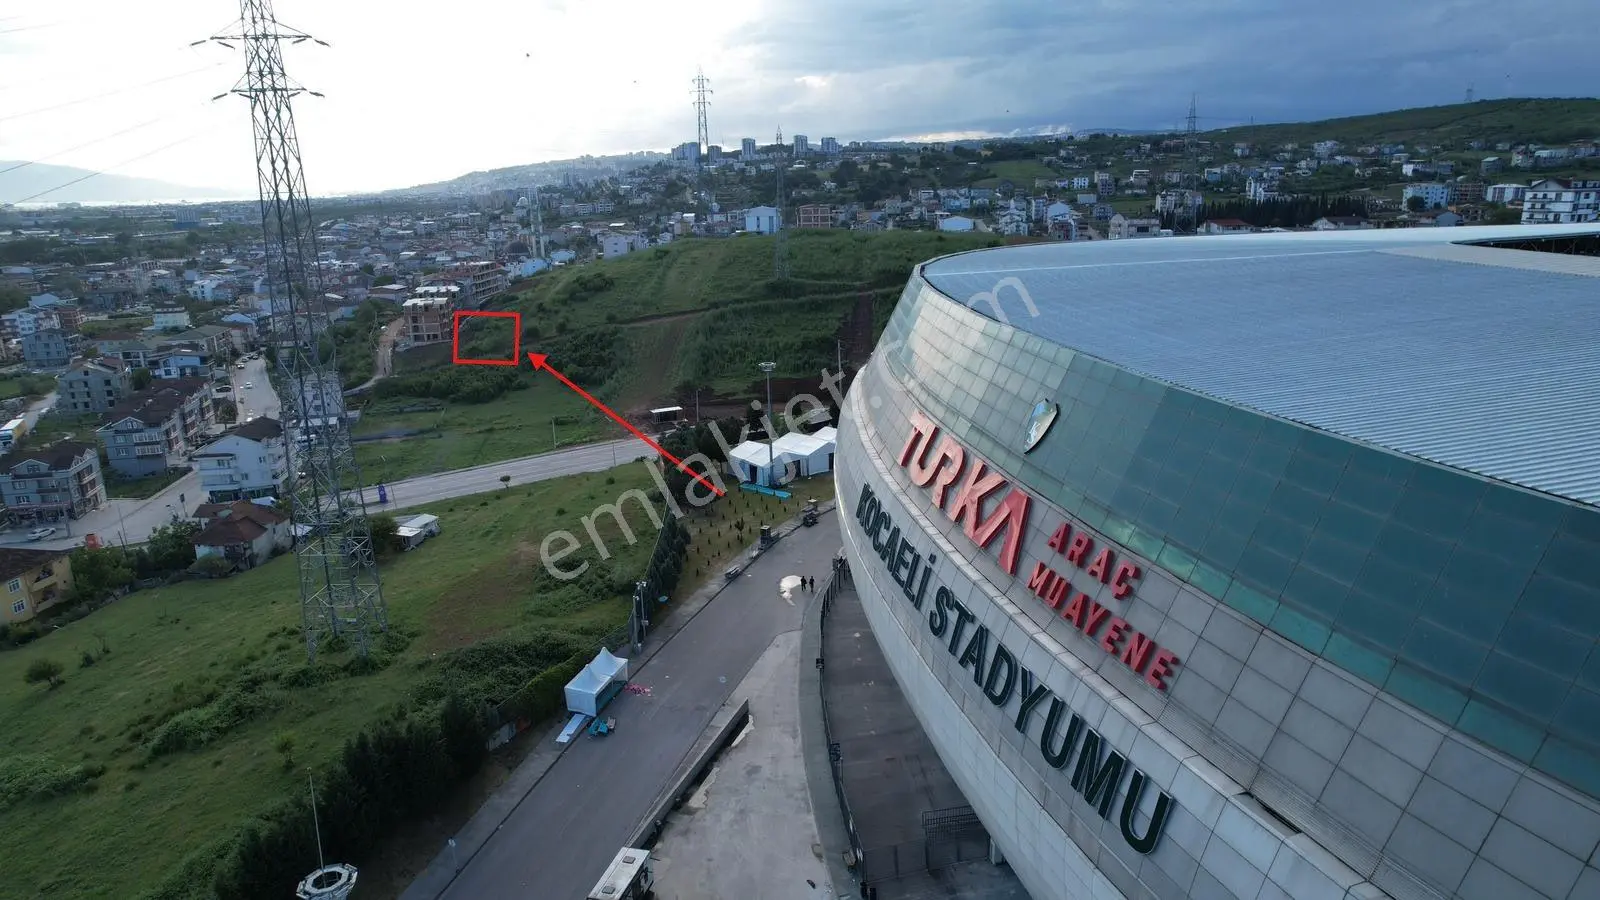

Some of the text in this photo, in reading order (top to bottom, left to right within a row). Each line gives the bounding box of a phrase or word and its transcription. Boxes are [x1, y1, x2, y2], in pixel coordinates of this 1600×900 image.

[898, 408, 1031, 577] TURKA
[855, 482, 1174, 855] KOCAELİ STADYUMU
[1025, 560, 1180, 692] MUAYENE
